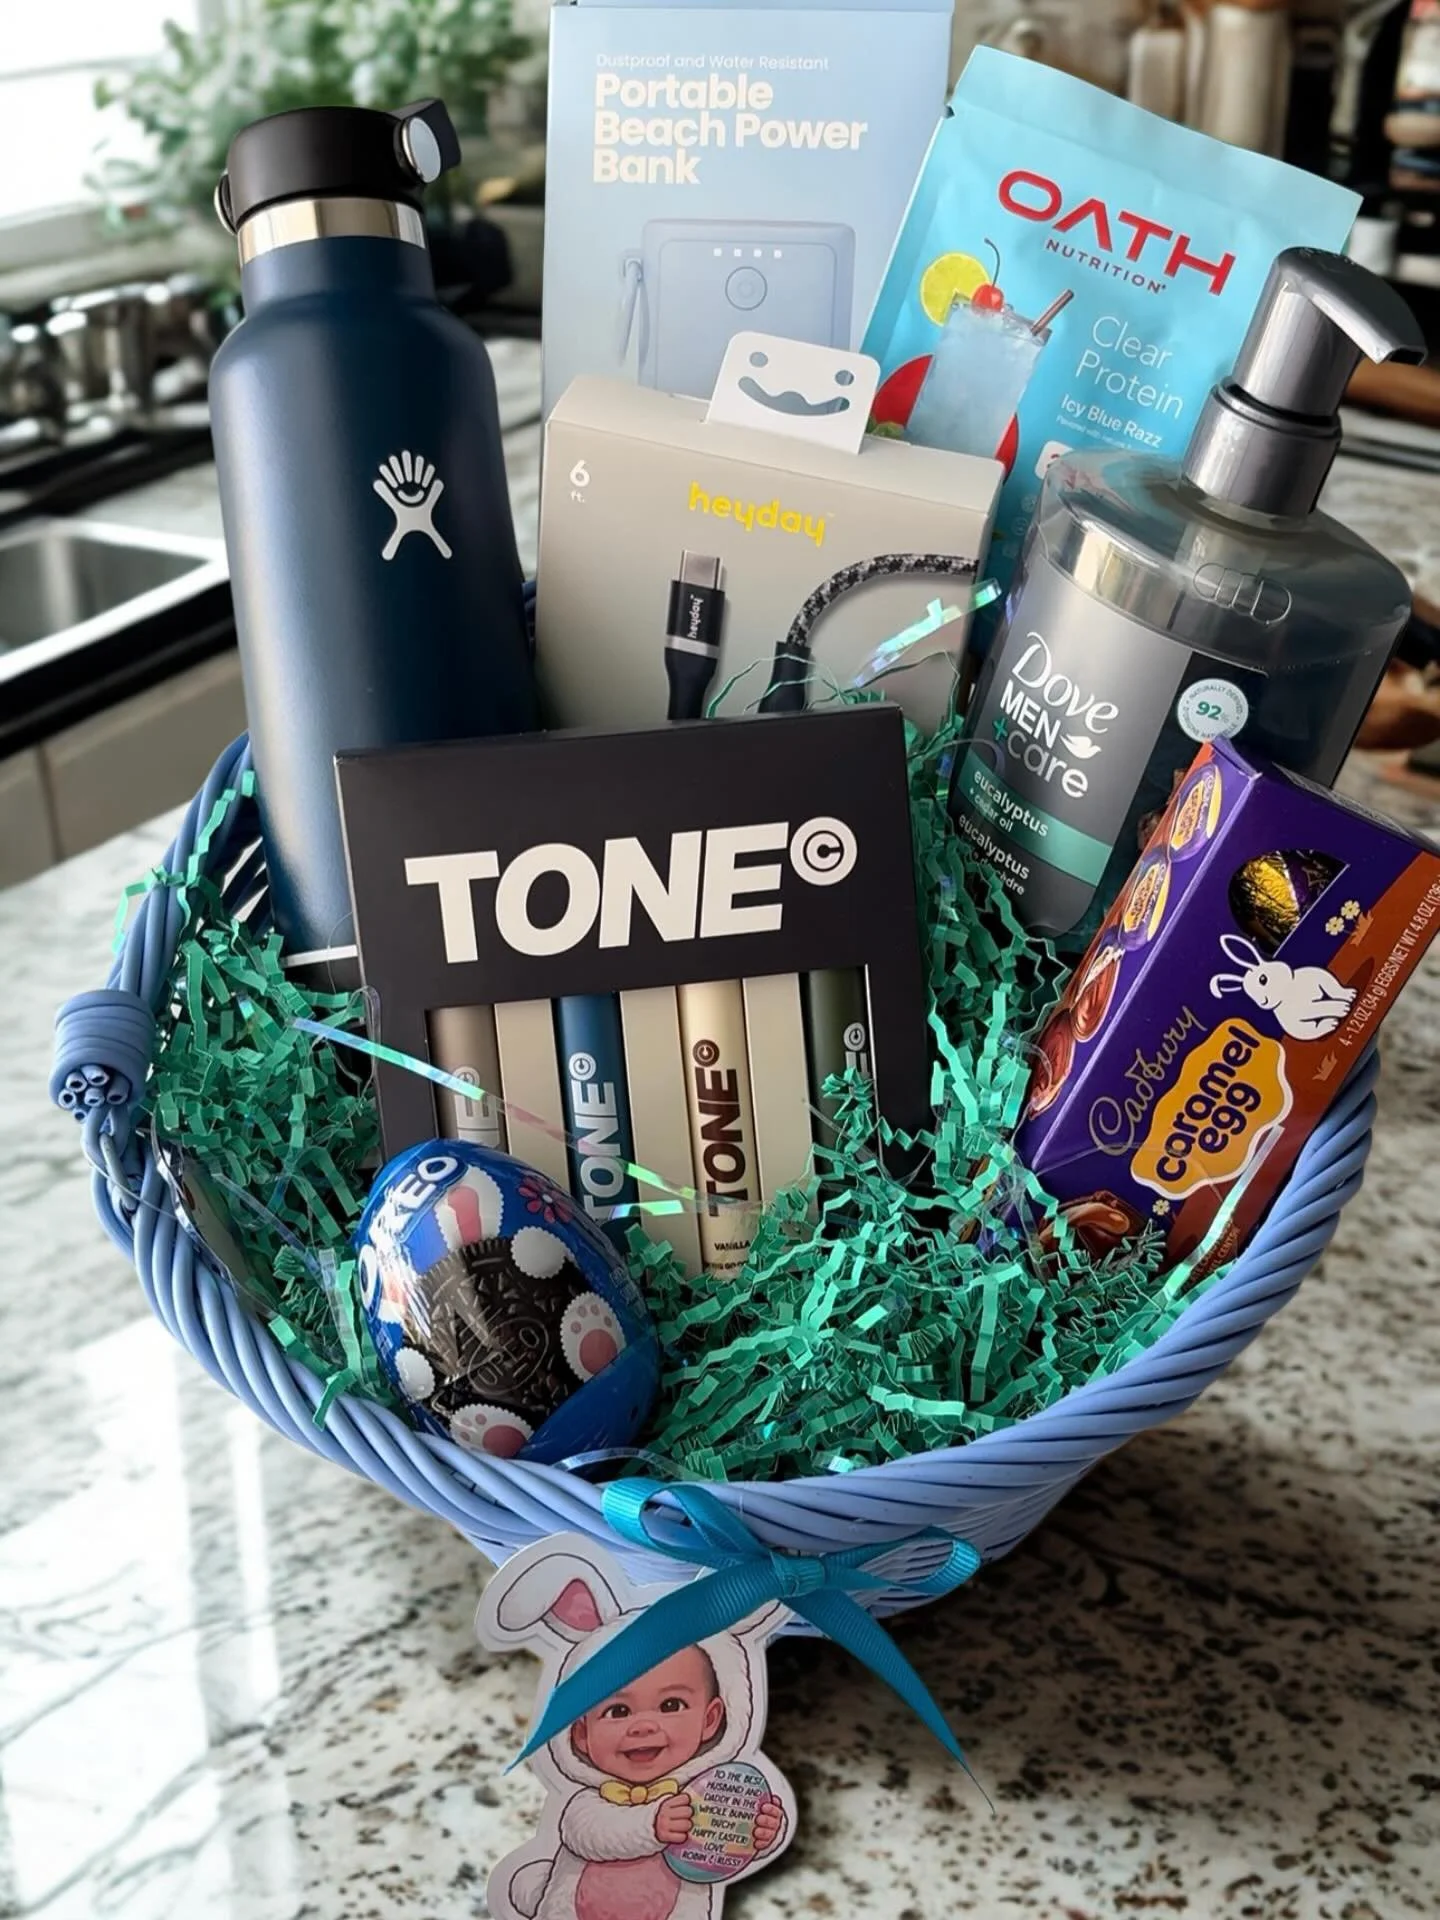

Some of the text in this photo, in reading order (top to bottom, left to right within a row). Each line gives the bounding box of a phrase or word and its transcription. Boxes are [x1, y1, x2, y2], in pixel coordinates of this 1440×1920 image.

[597, 54, 830, 71] Dustproof and Water Resistant
[595, 73, 774, 110] Portable
[594, 110, 869, 151] Beach Power
[592, 149, 701, 185] Bank
[998, 170, 1236, 296] OATH
[1092, 315, 1173, 370] Clear
[1075, 348, 1185, 420] Protein
[1061, 394, 1087, 418] Icy
[1087, 405, 1122, 431] Blue
[1123, 420, 1163, 448] Razz
[570, 459, 590, 487] 6
[1012, 632, 1119, 734] Dove
[1000, 679, 1061, 749] MEN
[974, 771, 1049, 837] eucalyptus
[1000, 817, 1013, 832] oil
[959, 815, 1030, 880] eucalyptus
[1354, 1006, 1372, 1021] OZ
[1400, 928, 1420, 946] WT
[1417, 902, 1437, 917] OZ
[1089, 1005, 1208, 1156] Cadbury
[1156, 1025, 1261, 1182] caramel
[1197, 1082, 1261, 1154] egg
[714, 1240, 751, 1251] VANILLA
[703, 1792, 757, 1809] DADDY IN THE
[706, 1781, 762, 1797] HUSBAND AND
[714, 1769, 764, 1785] TO THE BEST
[692, 1827, 717, 1839] HAPPY
[699, 1804, 756, 1821] WHOLE BUNNY
